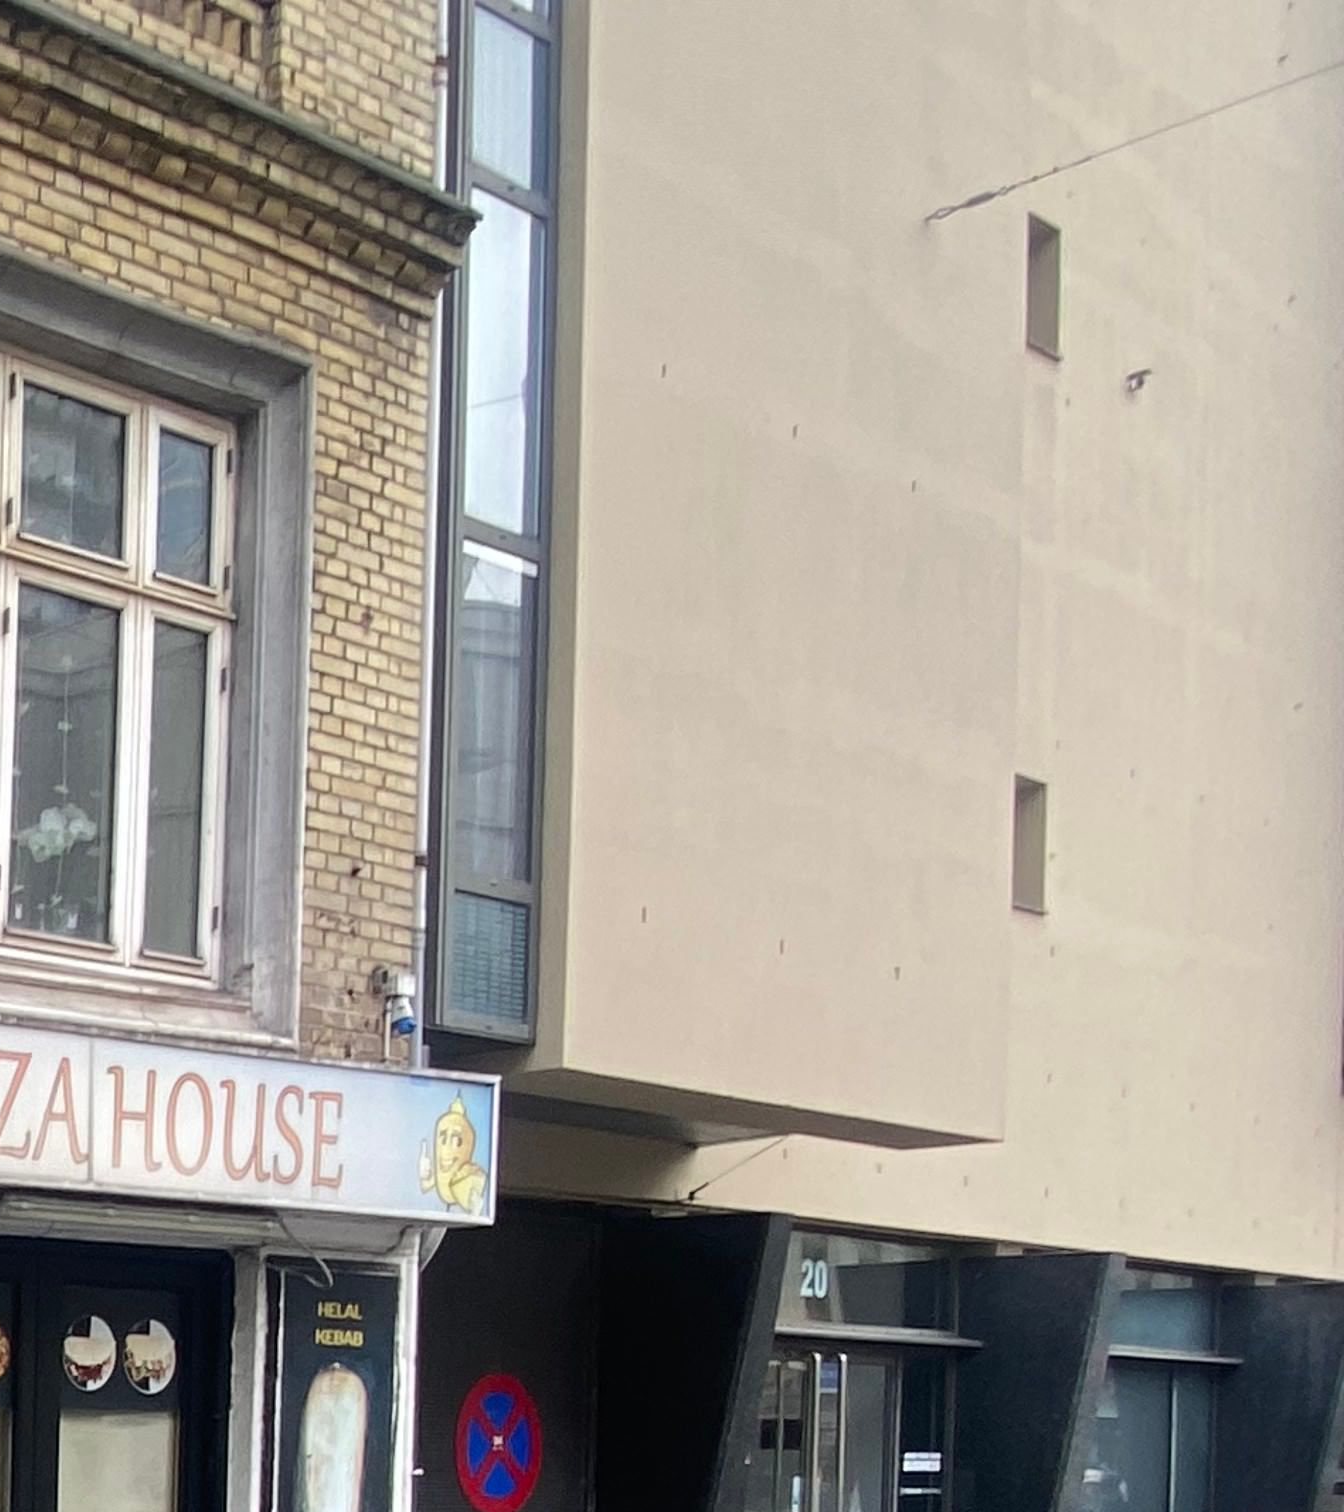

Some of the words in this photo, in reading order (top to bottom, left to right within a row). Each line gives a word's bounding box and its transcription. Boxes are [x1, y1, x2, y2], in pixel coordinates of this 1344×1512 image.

[105, 1063, 345, 1190] HOUSE
[800, 1259, 828, 1299] 20
[317, 1301, 363, 1320] HELAL
[315, 1328, 364, 1347] KEBAB
